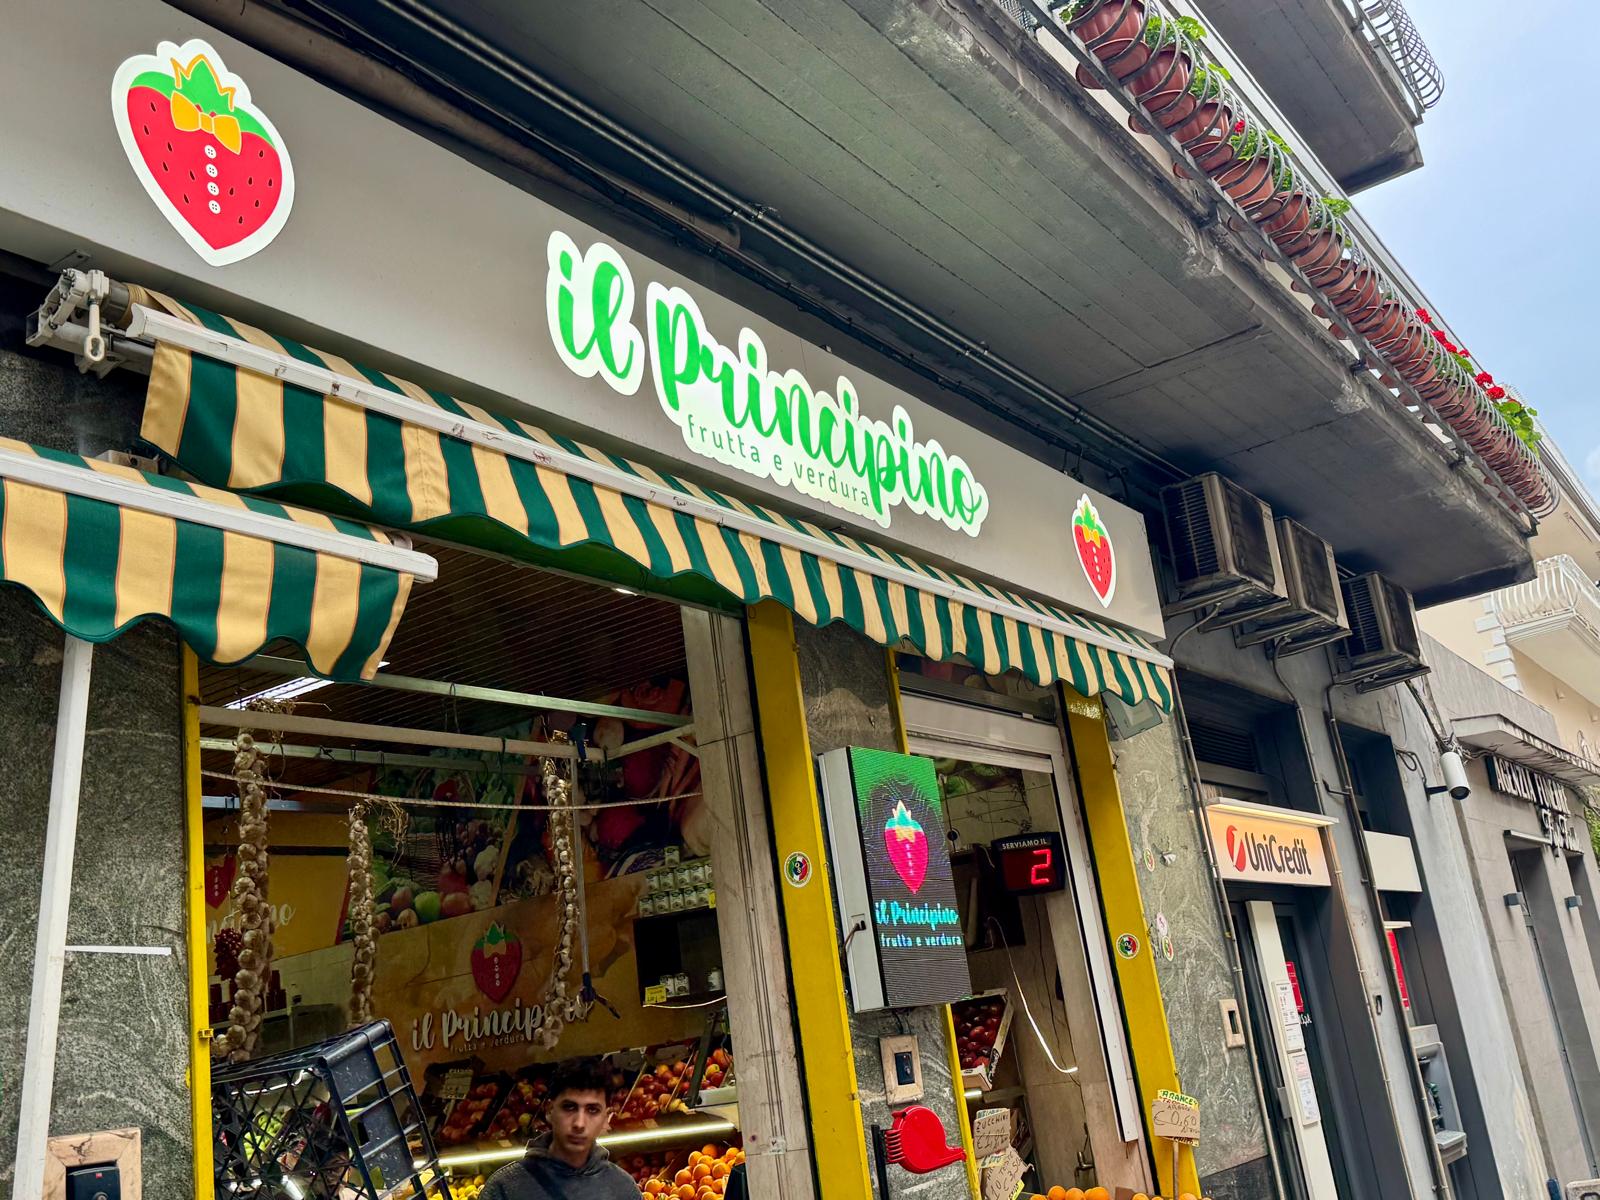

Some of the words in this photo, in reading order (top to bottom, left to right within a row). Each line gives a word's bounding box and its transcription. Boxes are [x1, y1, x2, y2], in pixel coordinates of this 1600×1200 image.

[558, 251, 634, 379] il
[656, 299, 982, 525] Principino
[687, 414, 761, 464] frutta
[773, 454, 783, 471] e
[793, 461, 870, 507] verdura
[1001, 839, 1039, 850] SERVIAMO
[1244, 831, 1312, 875] UniCredit
[1031, 848, 1052, 885] 2
[874, 899, 889, 925] il
[891, 900, 959, 931] Principino
[881, 932, 913, 947] frutta
[916, 936, 922, 946] e
[925, 933, 962, 946] verdura
[412, 1011, 435, 1051] il
